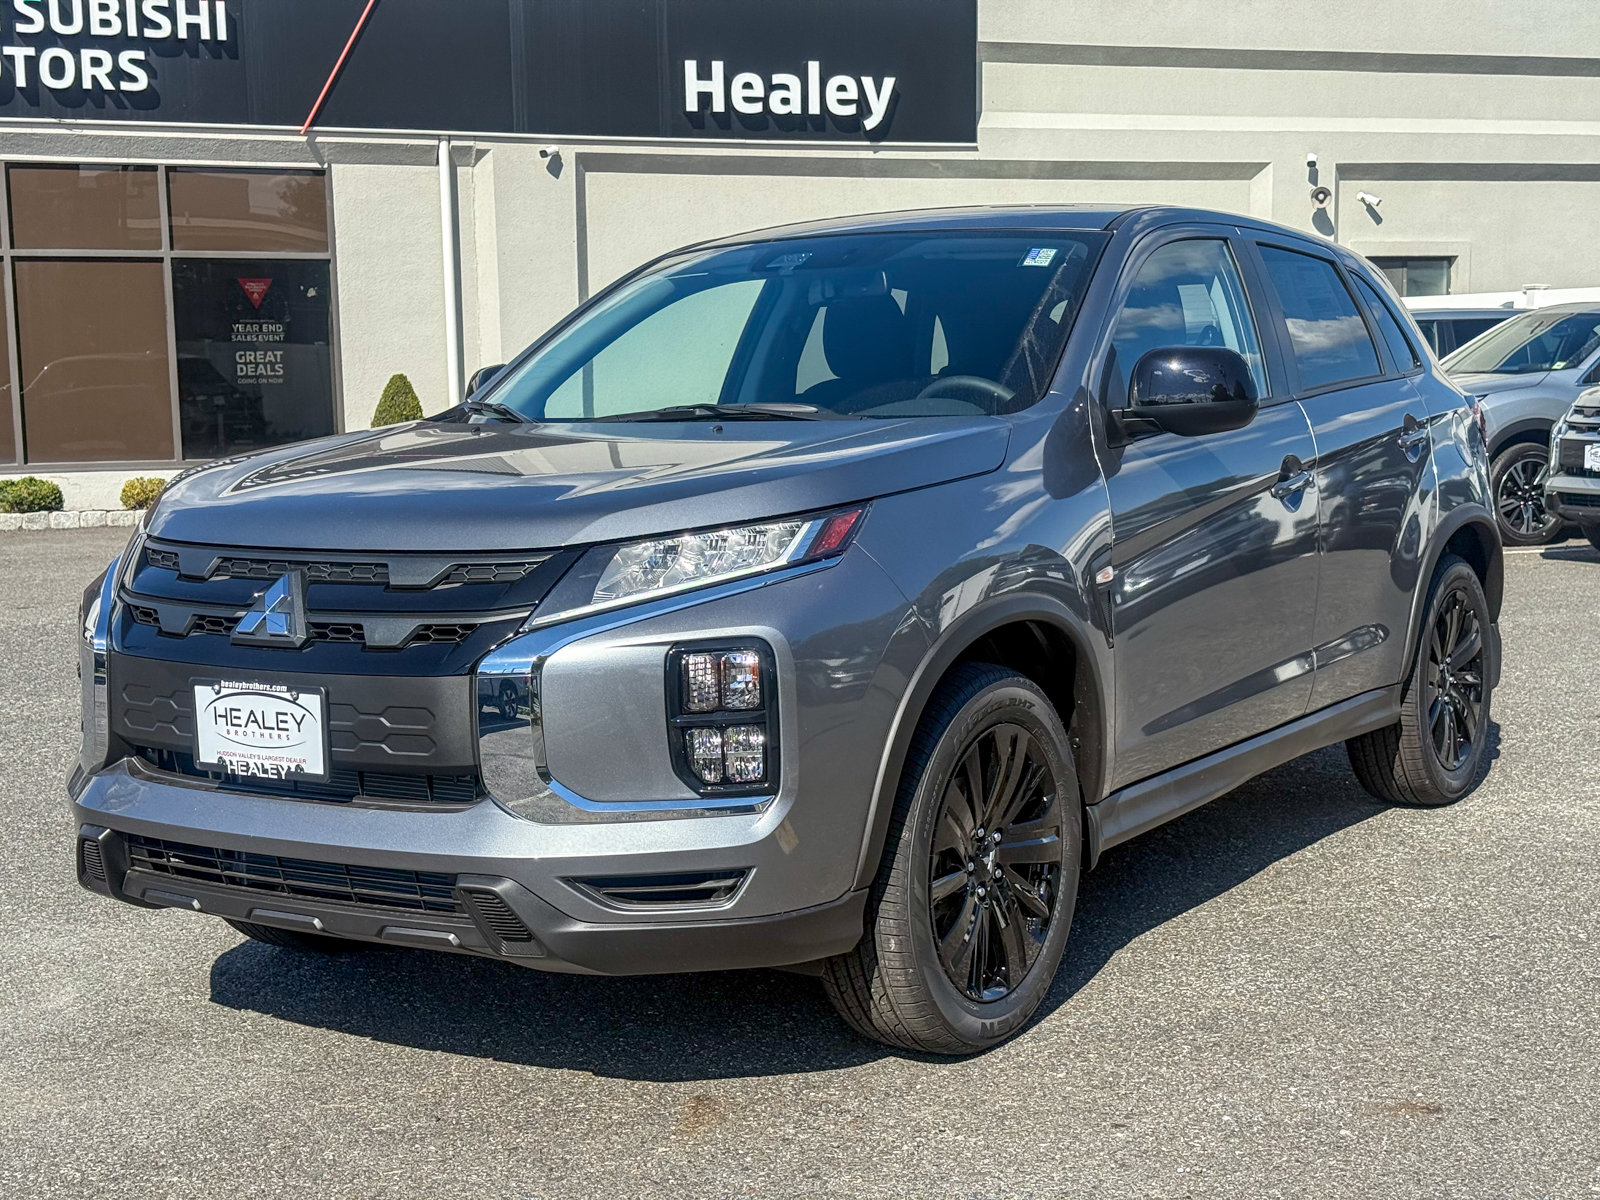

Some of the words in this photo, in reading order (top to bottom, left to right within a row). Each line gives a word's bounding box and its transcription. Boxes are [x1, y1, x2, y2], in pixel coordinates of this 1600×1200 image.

[0, 0, 227, 41] SUBISHI
[0, 46, 149, 91] TORS
[684, 59, 896, 131] Healey
[231, 323, 259, 332] YEAR
[262, 324, 283, 332] END
[235, 351, 284, 363] GREAT
[236, 363, 284, 376] DEALS
[1589, 450, 1600, 458] HE
[220, 680, 288, 692] healeybrothers.com
[213, 706, 306, 733] HEALEY
[226, 728, 290, 741] BROTHERS
[216, 750, 238, 758] HUDSON
[261, 754, 285, 762] LARGEST
[226, 759, 289, 780] HEALEY
